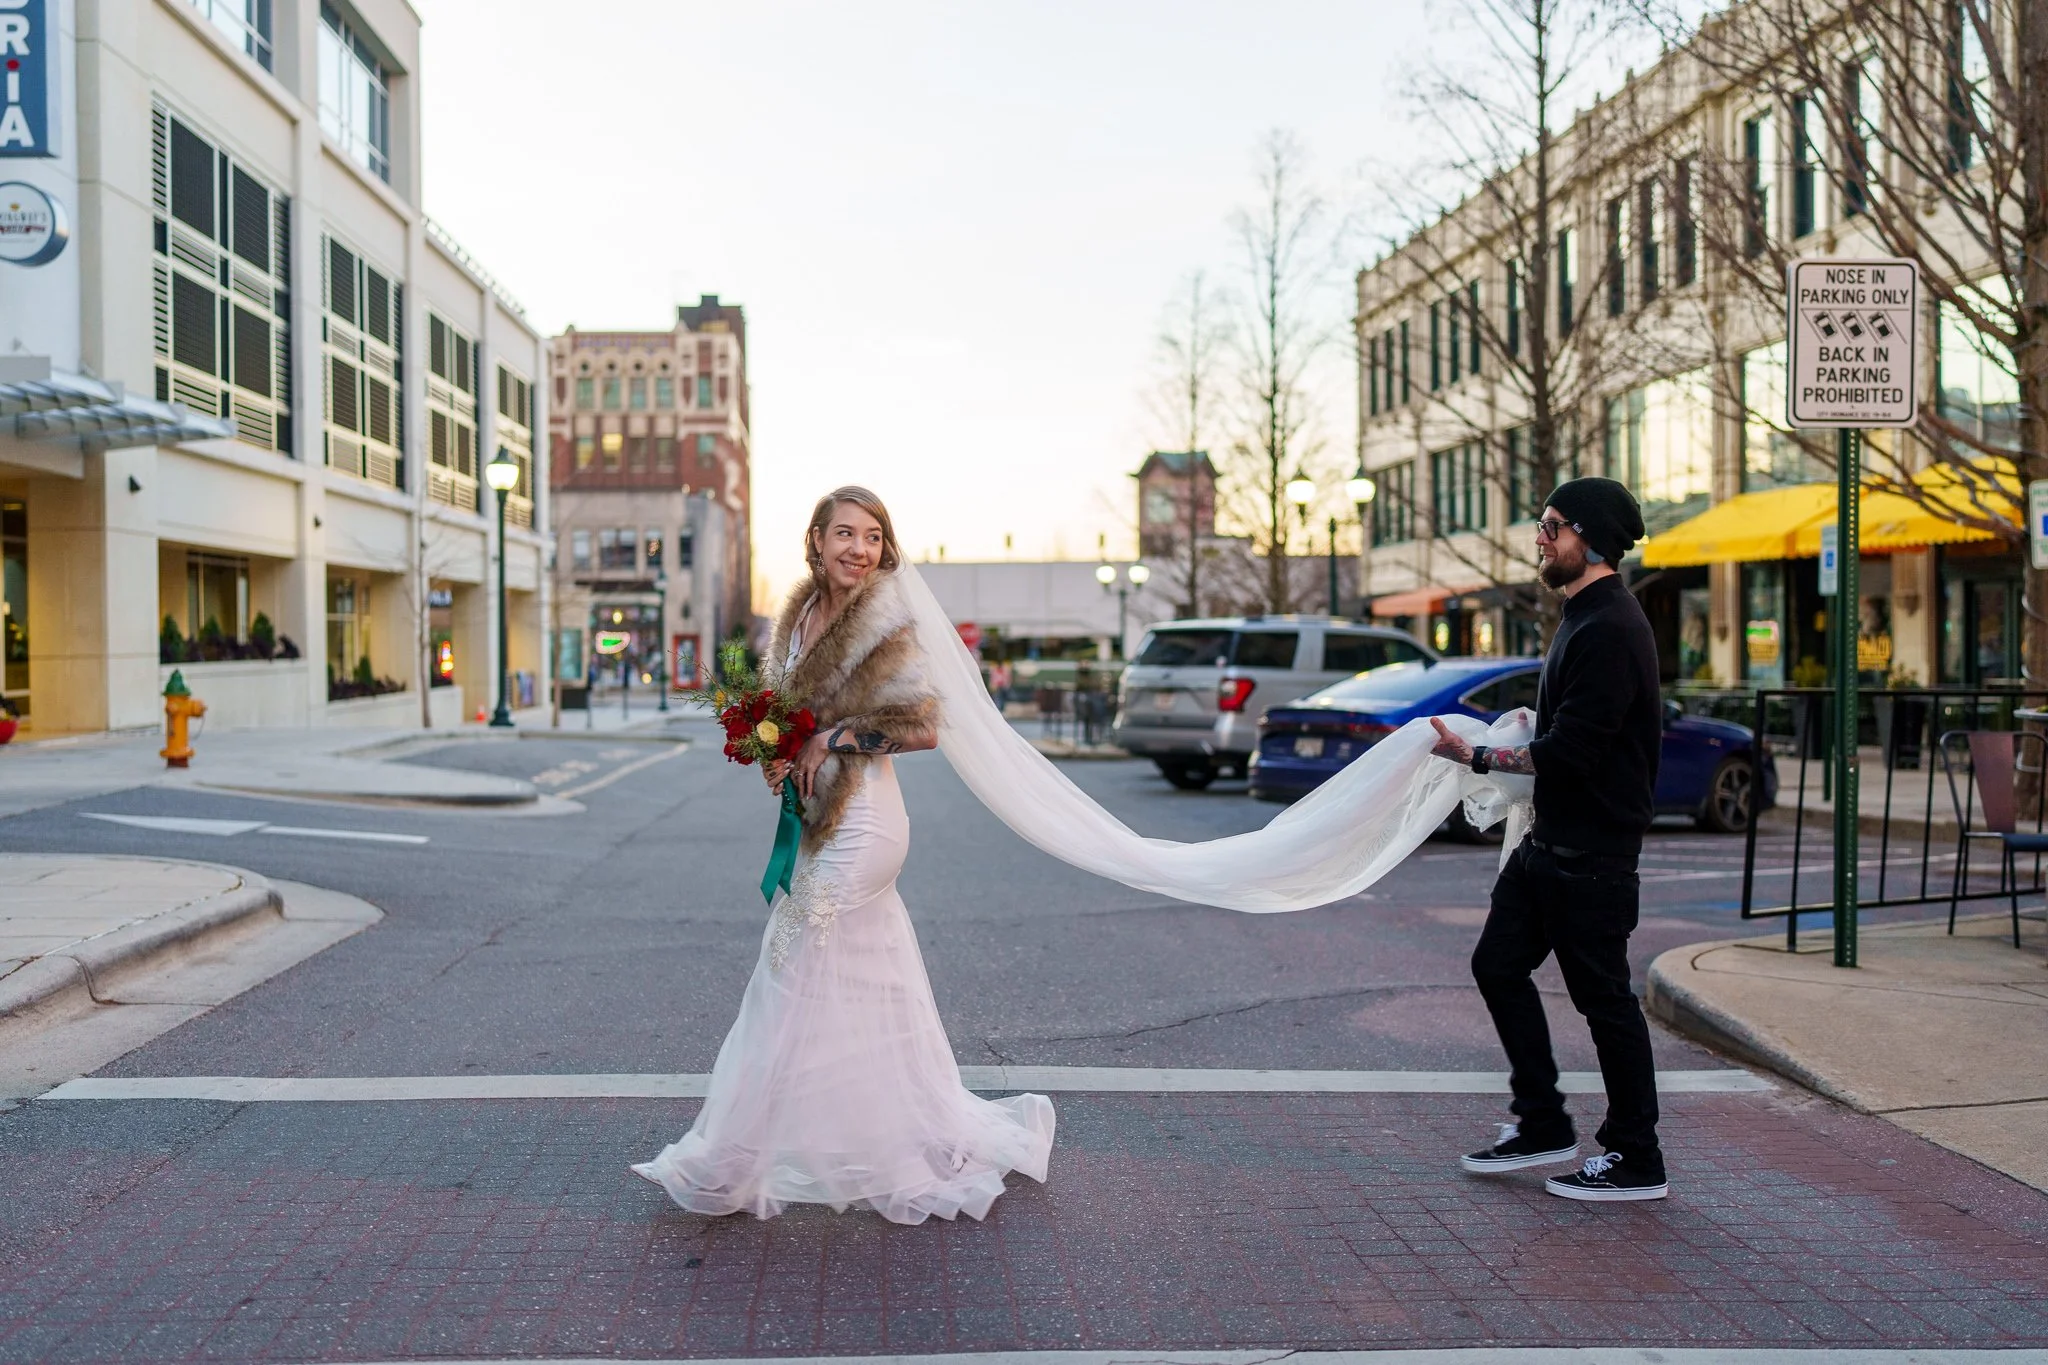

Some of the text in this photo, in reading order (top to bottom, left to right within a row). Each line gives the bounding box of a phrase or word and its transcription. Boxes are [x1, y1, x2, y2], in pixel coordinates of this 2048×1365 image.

[1826, 268, 1886, 284] NOSE IN
[1801, 288, 1909, 305] PARKING ONLY
[1819, 346, 1889, 362] BACK IN
[1816, 367, 1890, 383] PARKING
[1803, 387, 1903, 403] PROHIBITED
